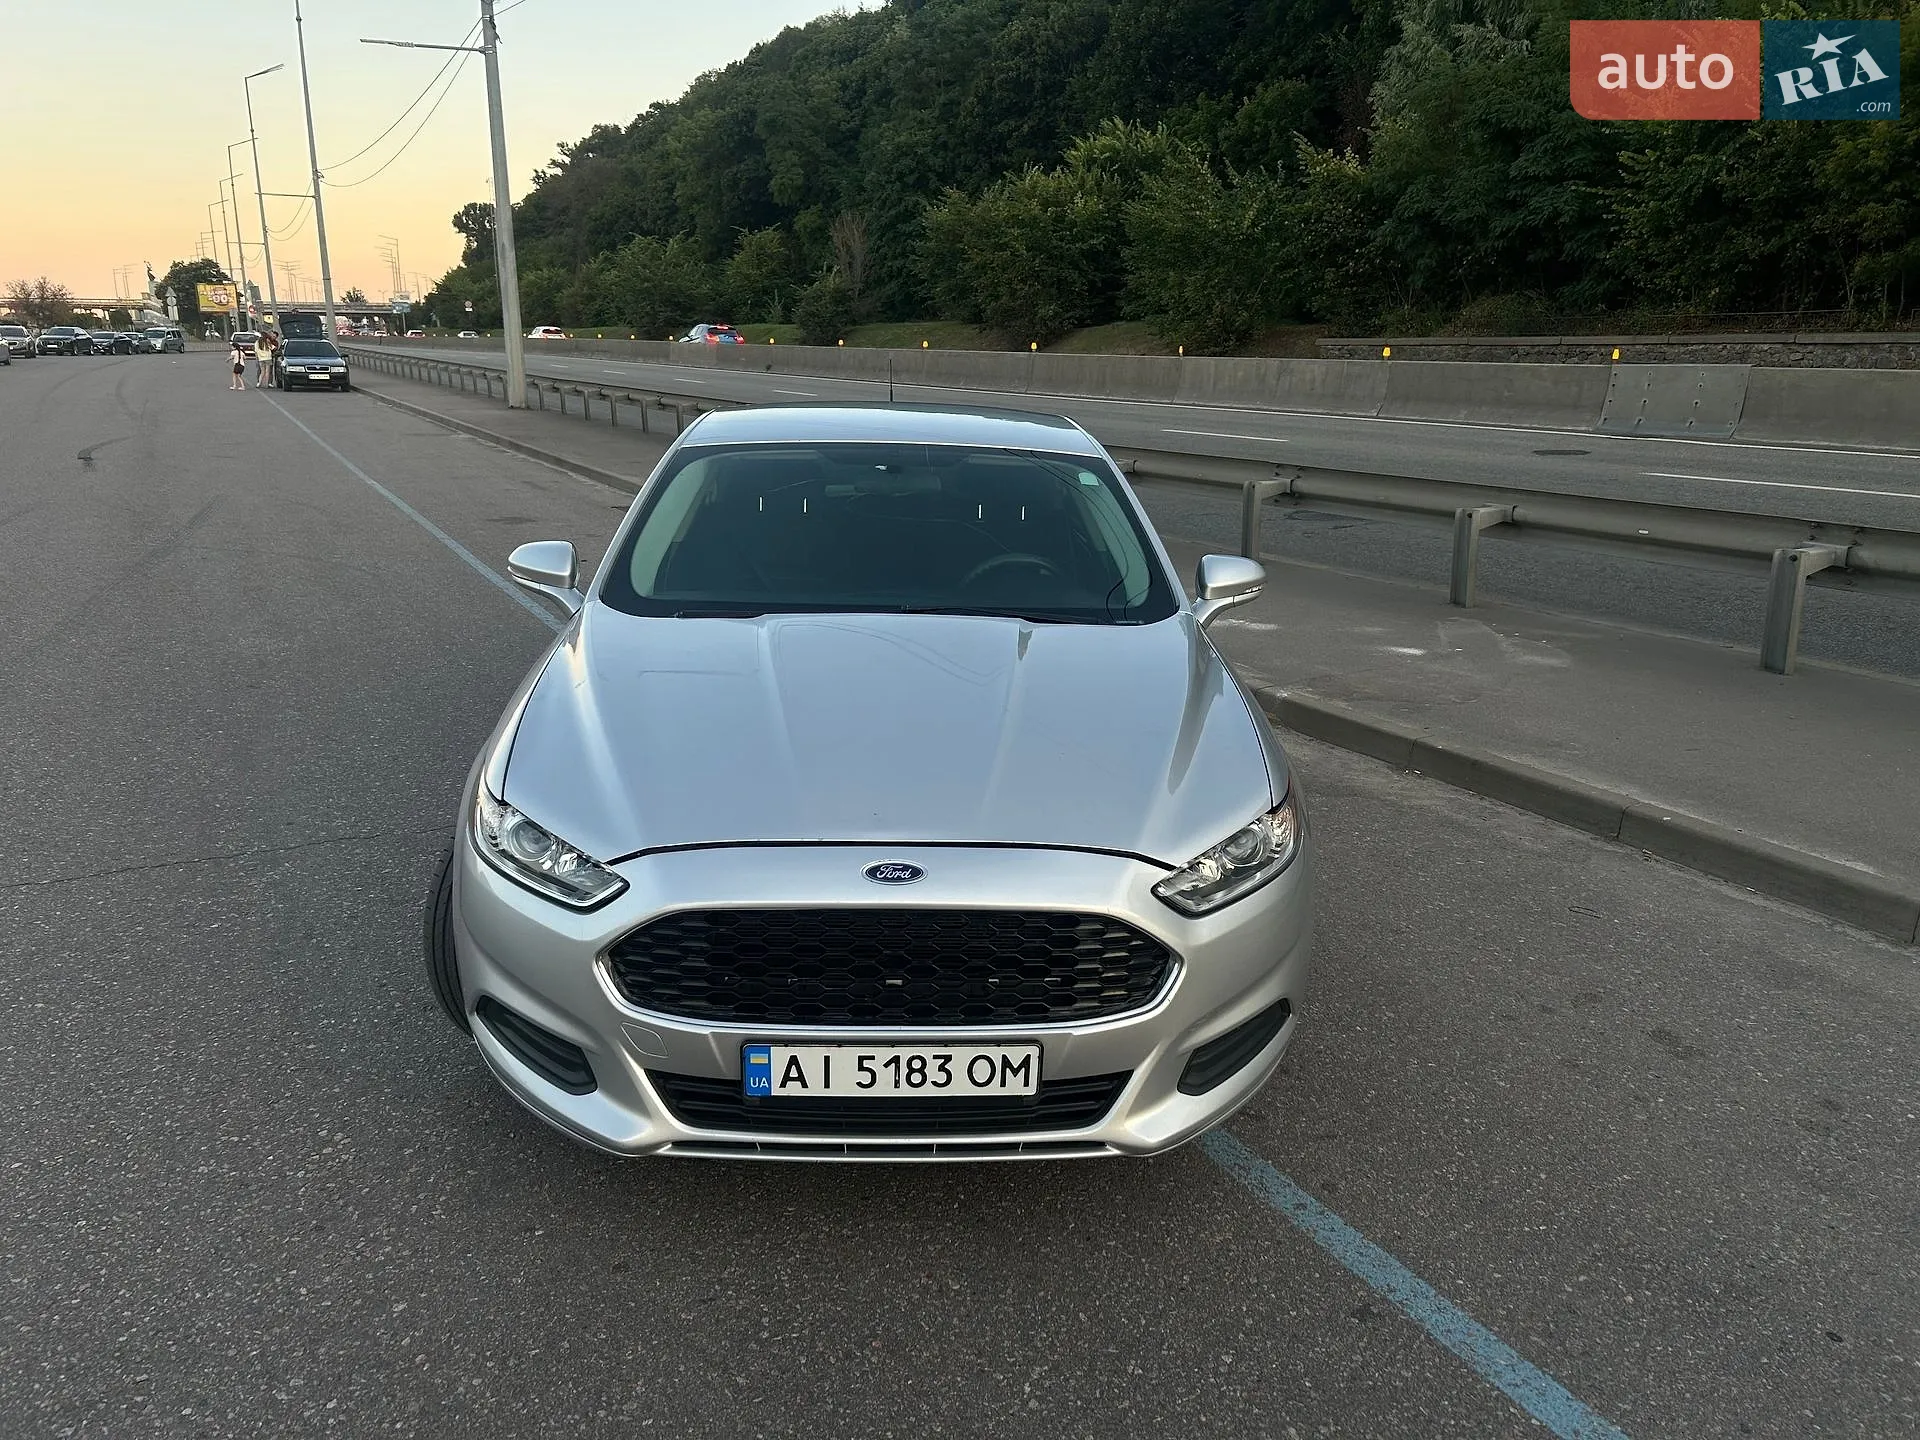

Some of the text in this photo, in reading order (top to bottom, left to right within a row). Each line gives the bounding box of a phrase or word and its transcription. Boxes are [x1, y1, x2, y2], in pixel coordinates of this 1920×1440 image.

[876, 865, 912, 879] Ford
[779, 1053, 1031, 1089] AI 5183 OM
[750, 1077, 769, 1088] UA
